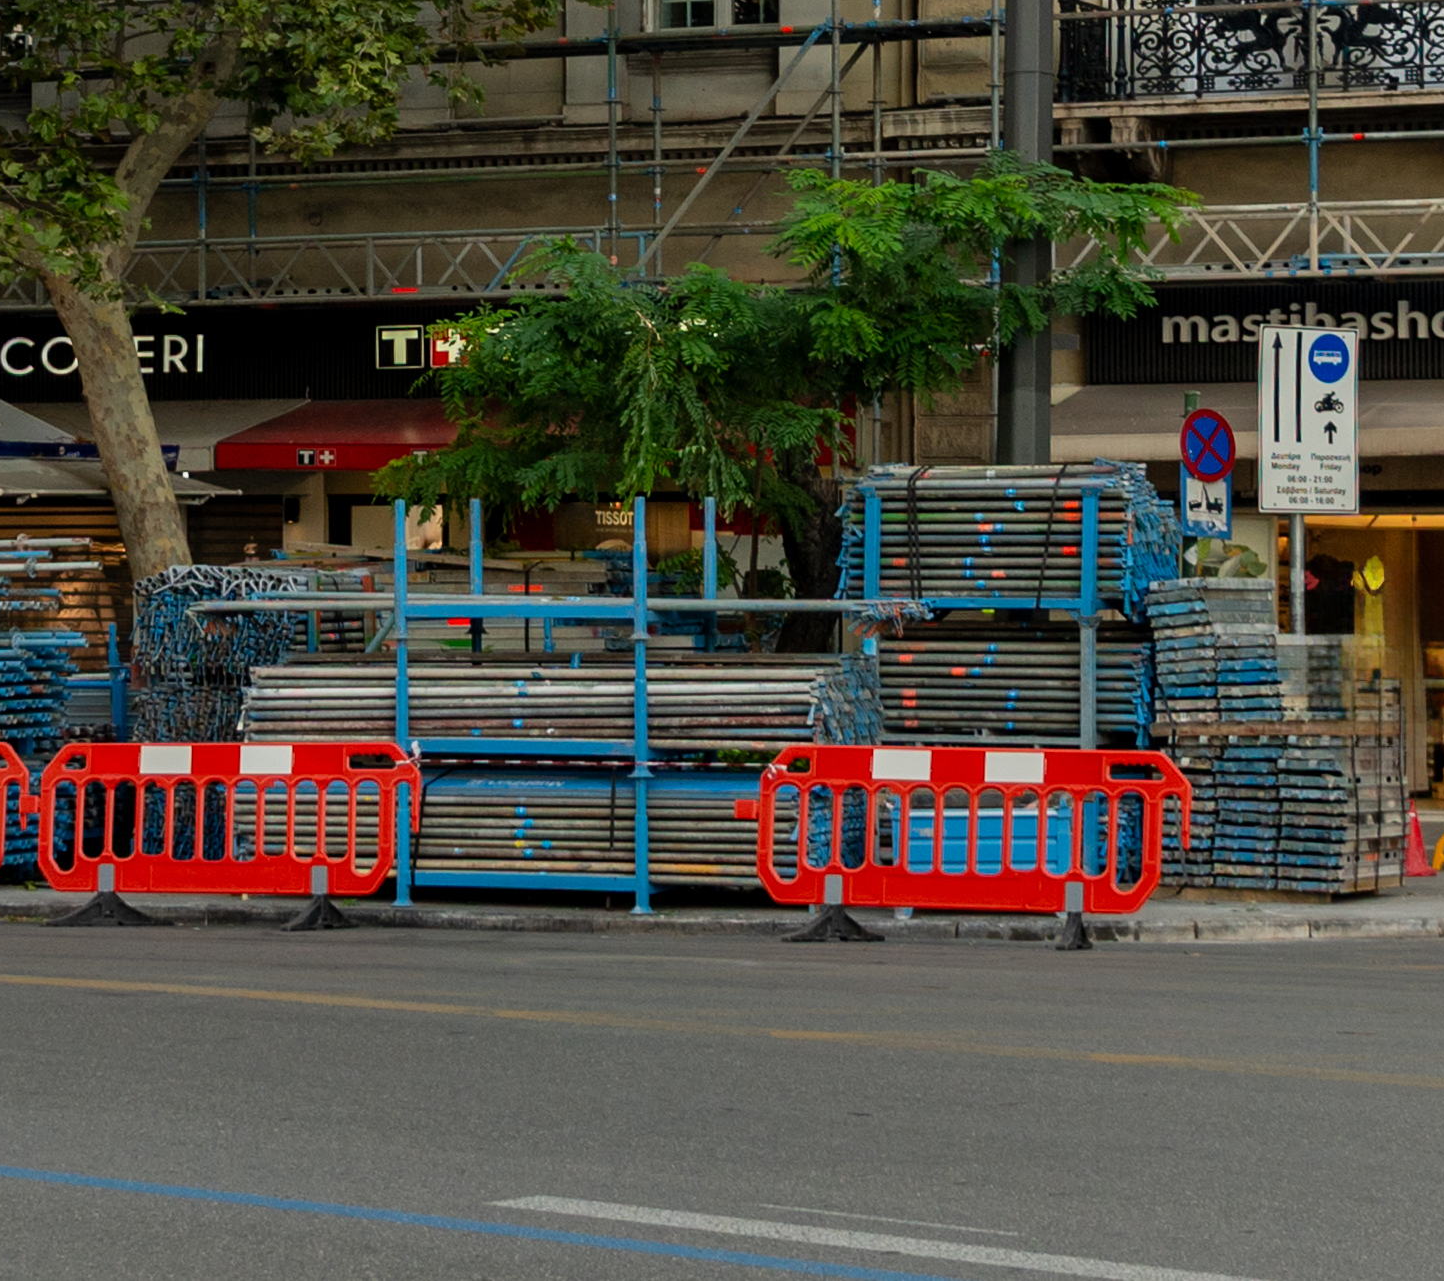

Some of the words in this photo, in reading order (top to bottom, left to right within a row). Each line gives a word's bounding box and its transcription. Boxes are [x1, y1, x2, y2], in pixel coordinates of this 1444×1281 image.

[1271, 461, 1300, 471] Monday
[1320, 462, 1342, 472] Friday
[594, 510, 634, 526] TISSOT
